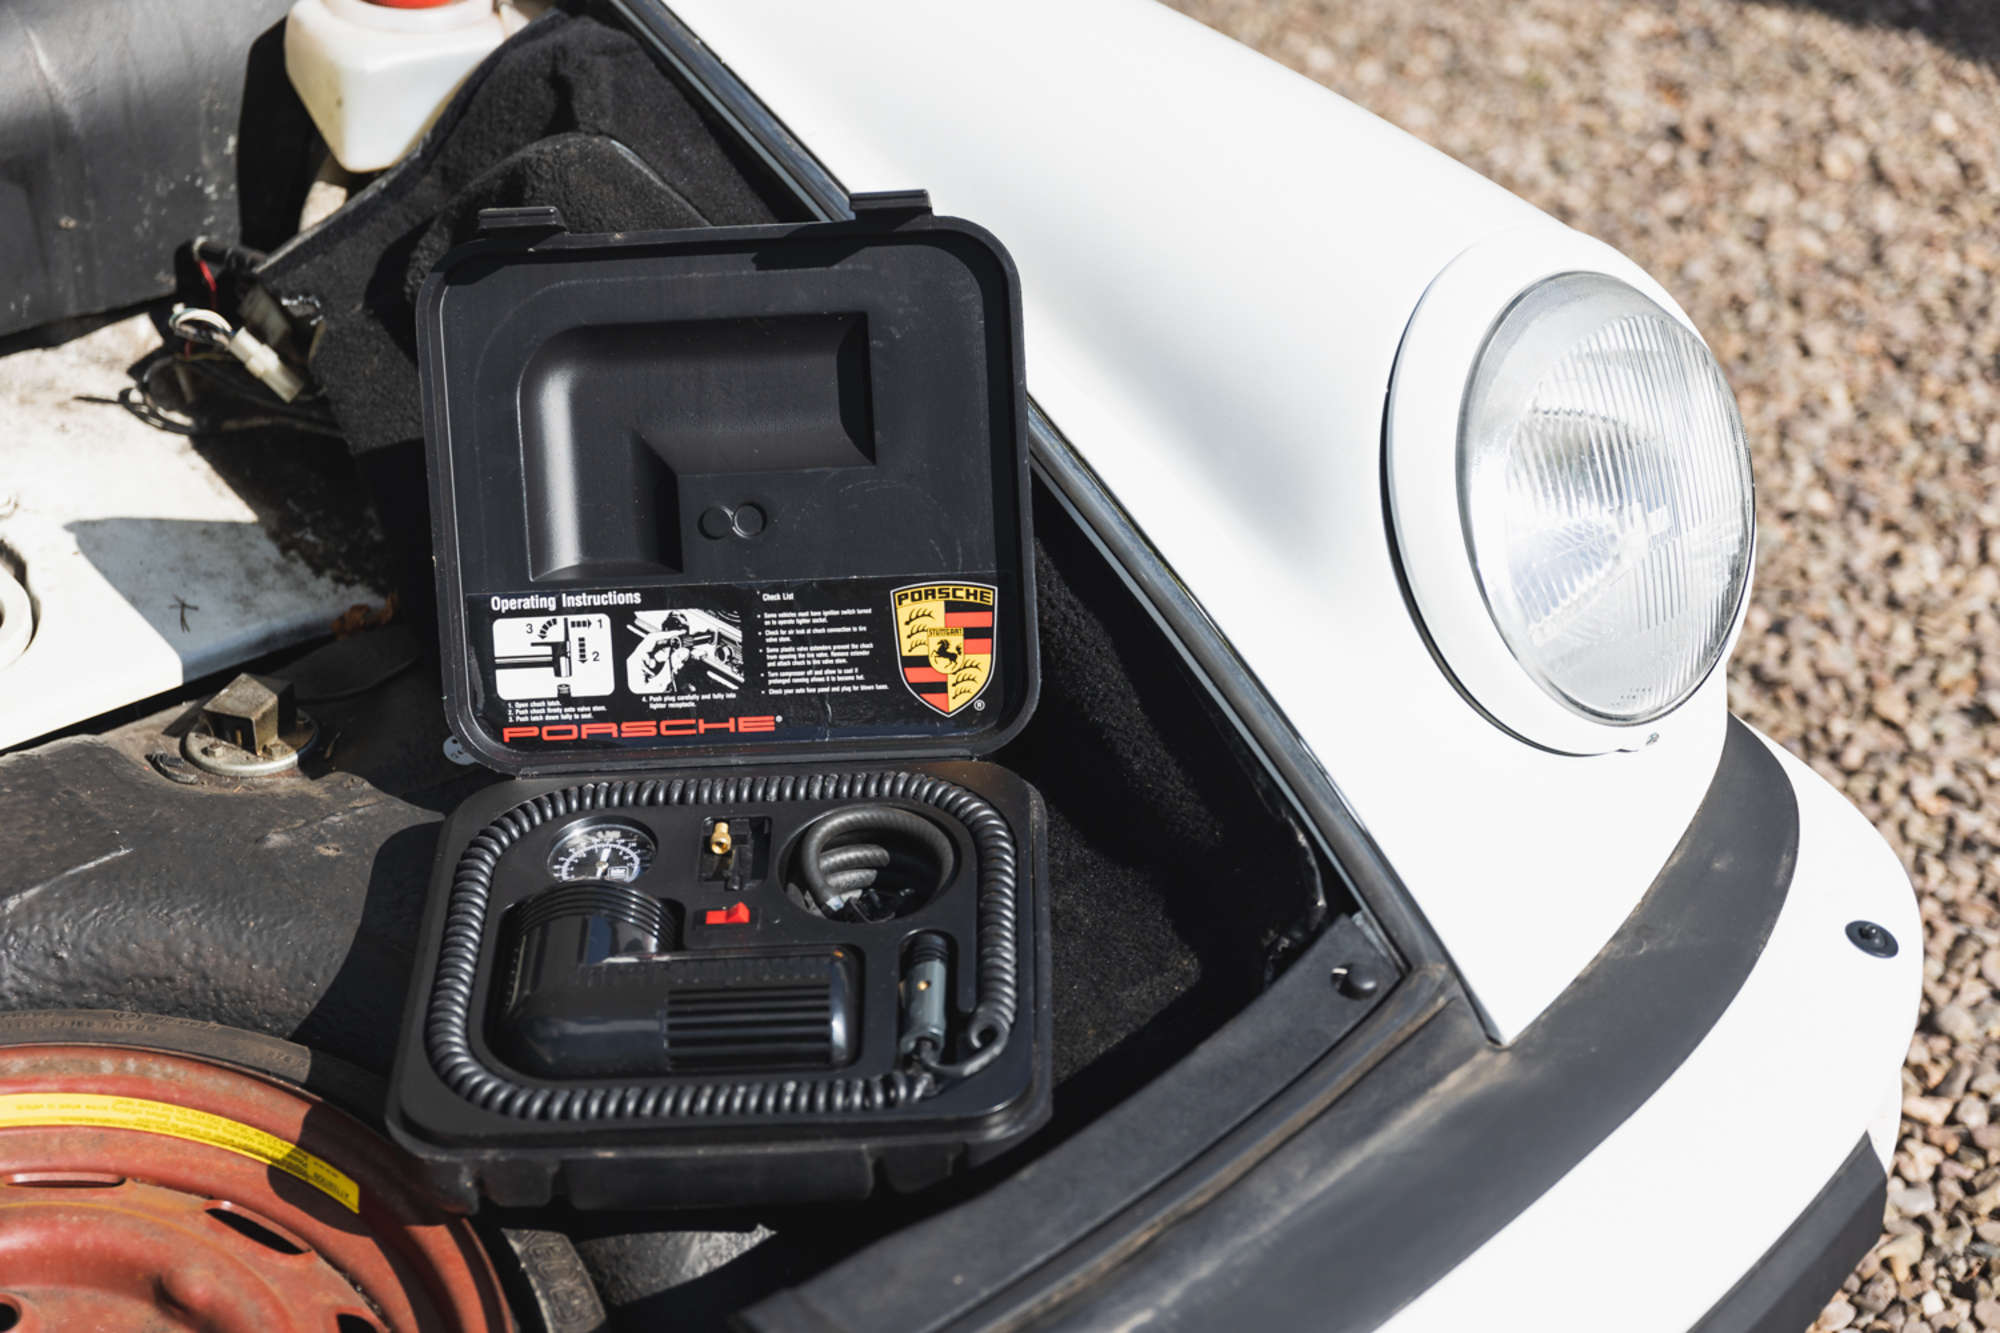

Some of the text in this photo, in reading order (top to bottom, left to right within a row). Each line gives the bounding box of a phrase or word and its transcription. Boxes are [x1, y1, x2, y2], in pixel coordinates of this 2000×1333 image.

[491, 591, 642, 613] Operating Instructions
[762, 593, 781, 601] Check
[898, 588, 992, 606] PORSCHE
[526, 624, 533, 634] 3
[597, 619, 603, 629] 1
[592, 651, 600, 662] 2
[502, 715, 776, 743] PORSCHE
